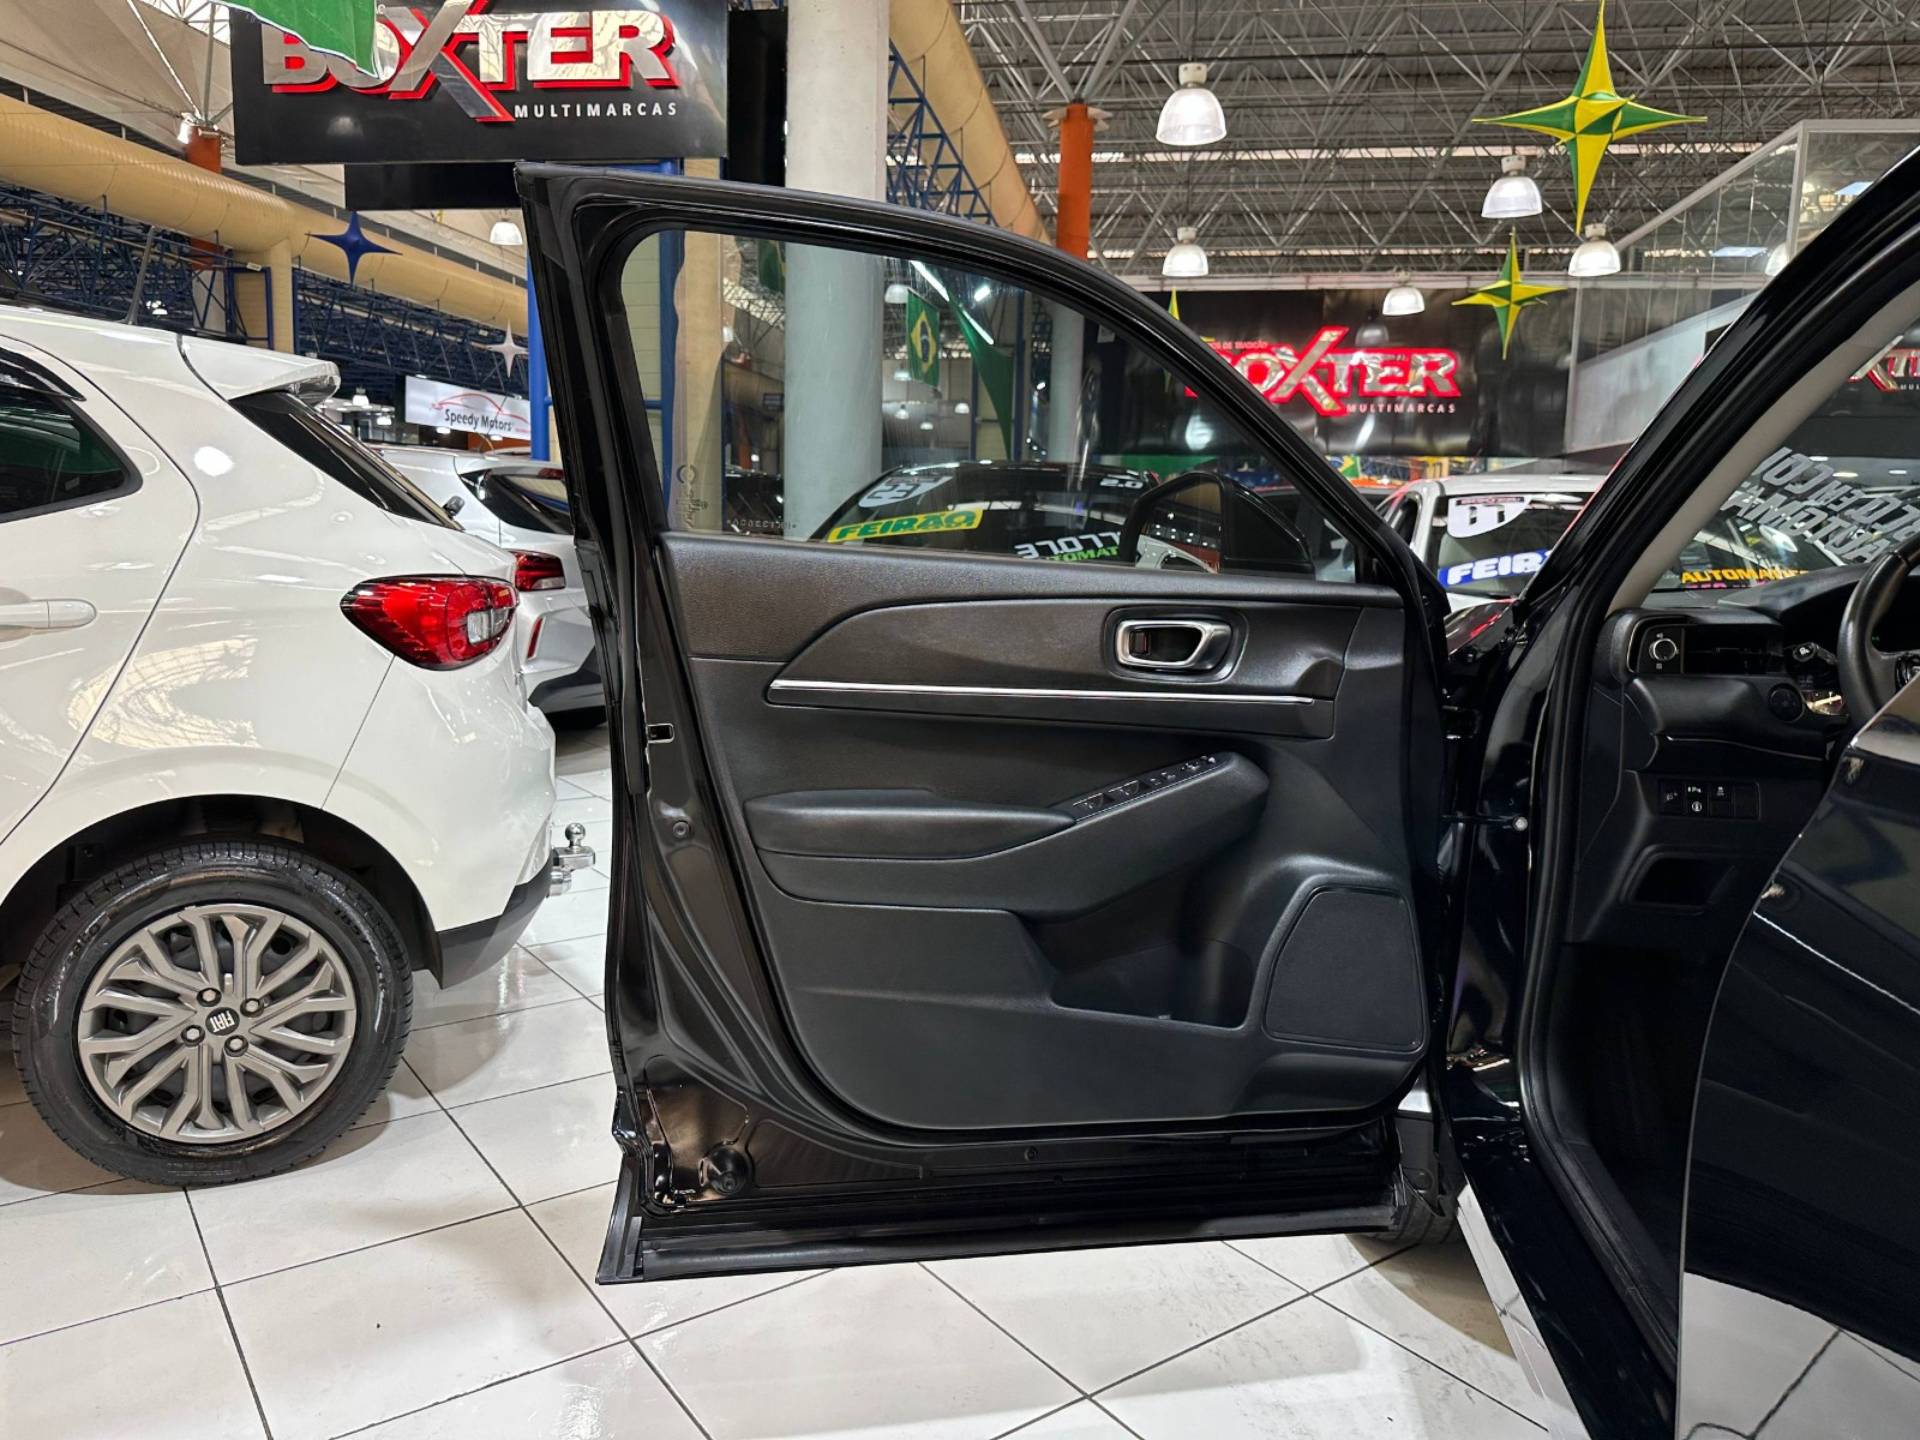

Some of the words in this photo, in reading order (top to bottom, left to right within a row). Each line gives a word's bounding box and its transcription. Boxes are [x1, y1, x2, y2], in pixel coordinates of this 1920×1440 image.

[514, 103, 677, 119] MULTIMARCAS
[1220, 326, 1461, 416] OXTER
[444, 408, 479, 431] Speedy
[481, 415, 513, 431] Motors
[1346, 403, 1456, 414] MULTIMARCAS
[1447, 550, 1552, 585] FEIR
[210, 1010, 235, 1033] FIAT
